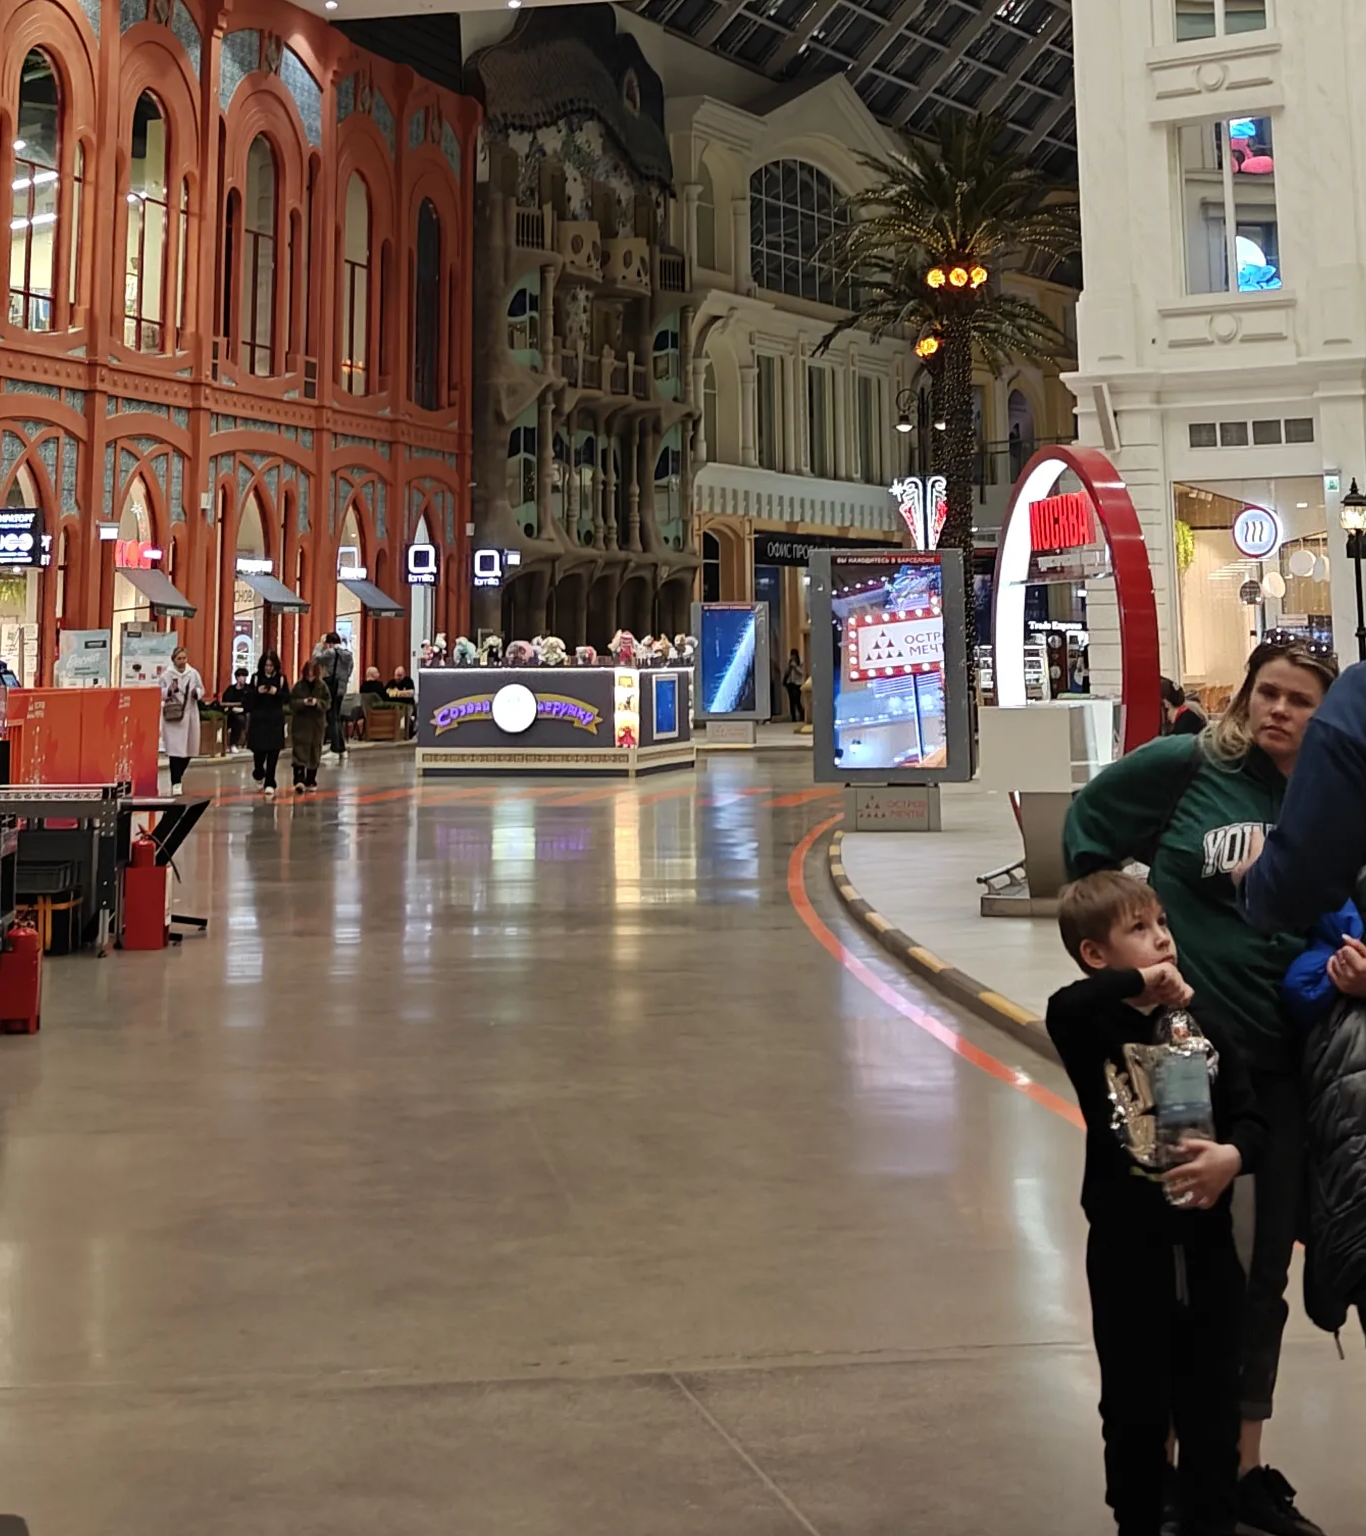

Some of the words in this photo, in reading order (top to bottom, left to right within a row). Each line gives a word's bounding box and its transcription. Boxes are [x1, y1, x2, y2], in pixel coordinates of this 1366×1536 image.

[1029, 490, 1090, 551] МОСКВА
[767, 541, 793, 558] ОФИС
[909, 642, 943, 657] МЕЧ
